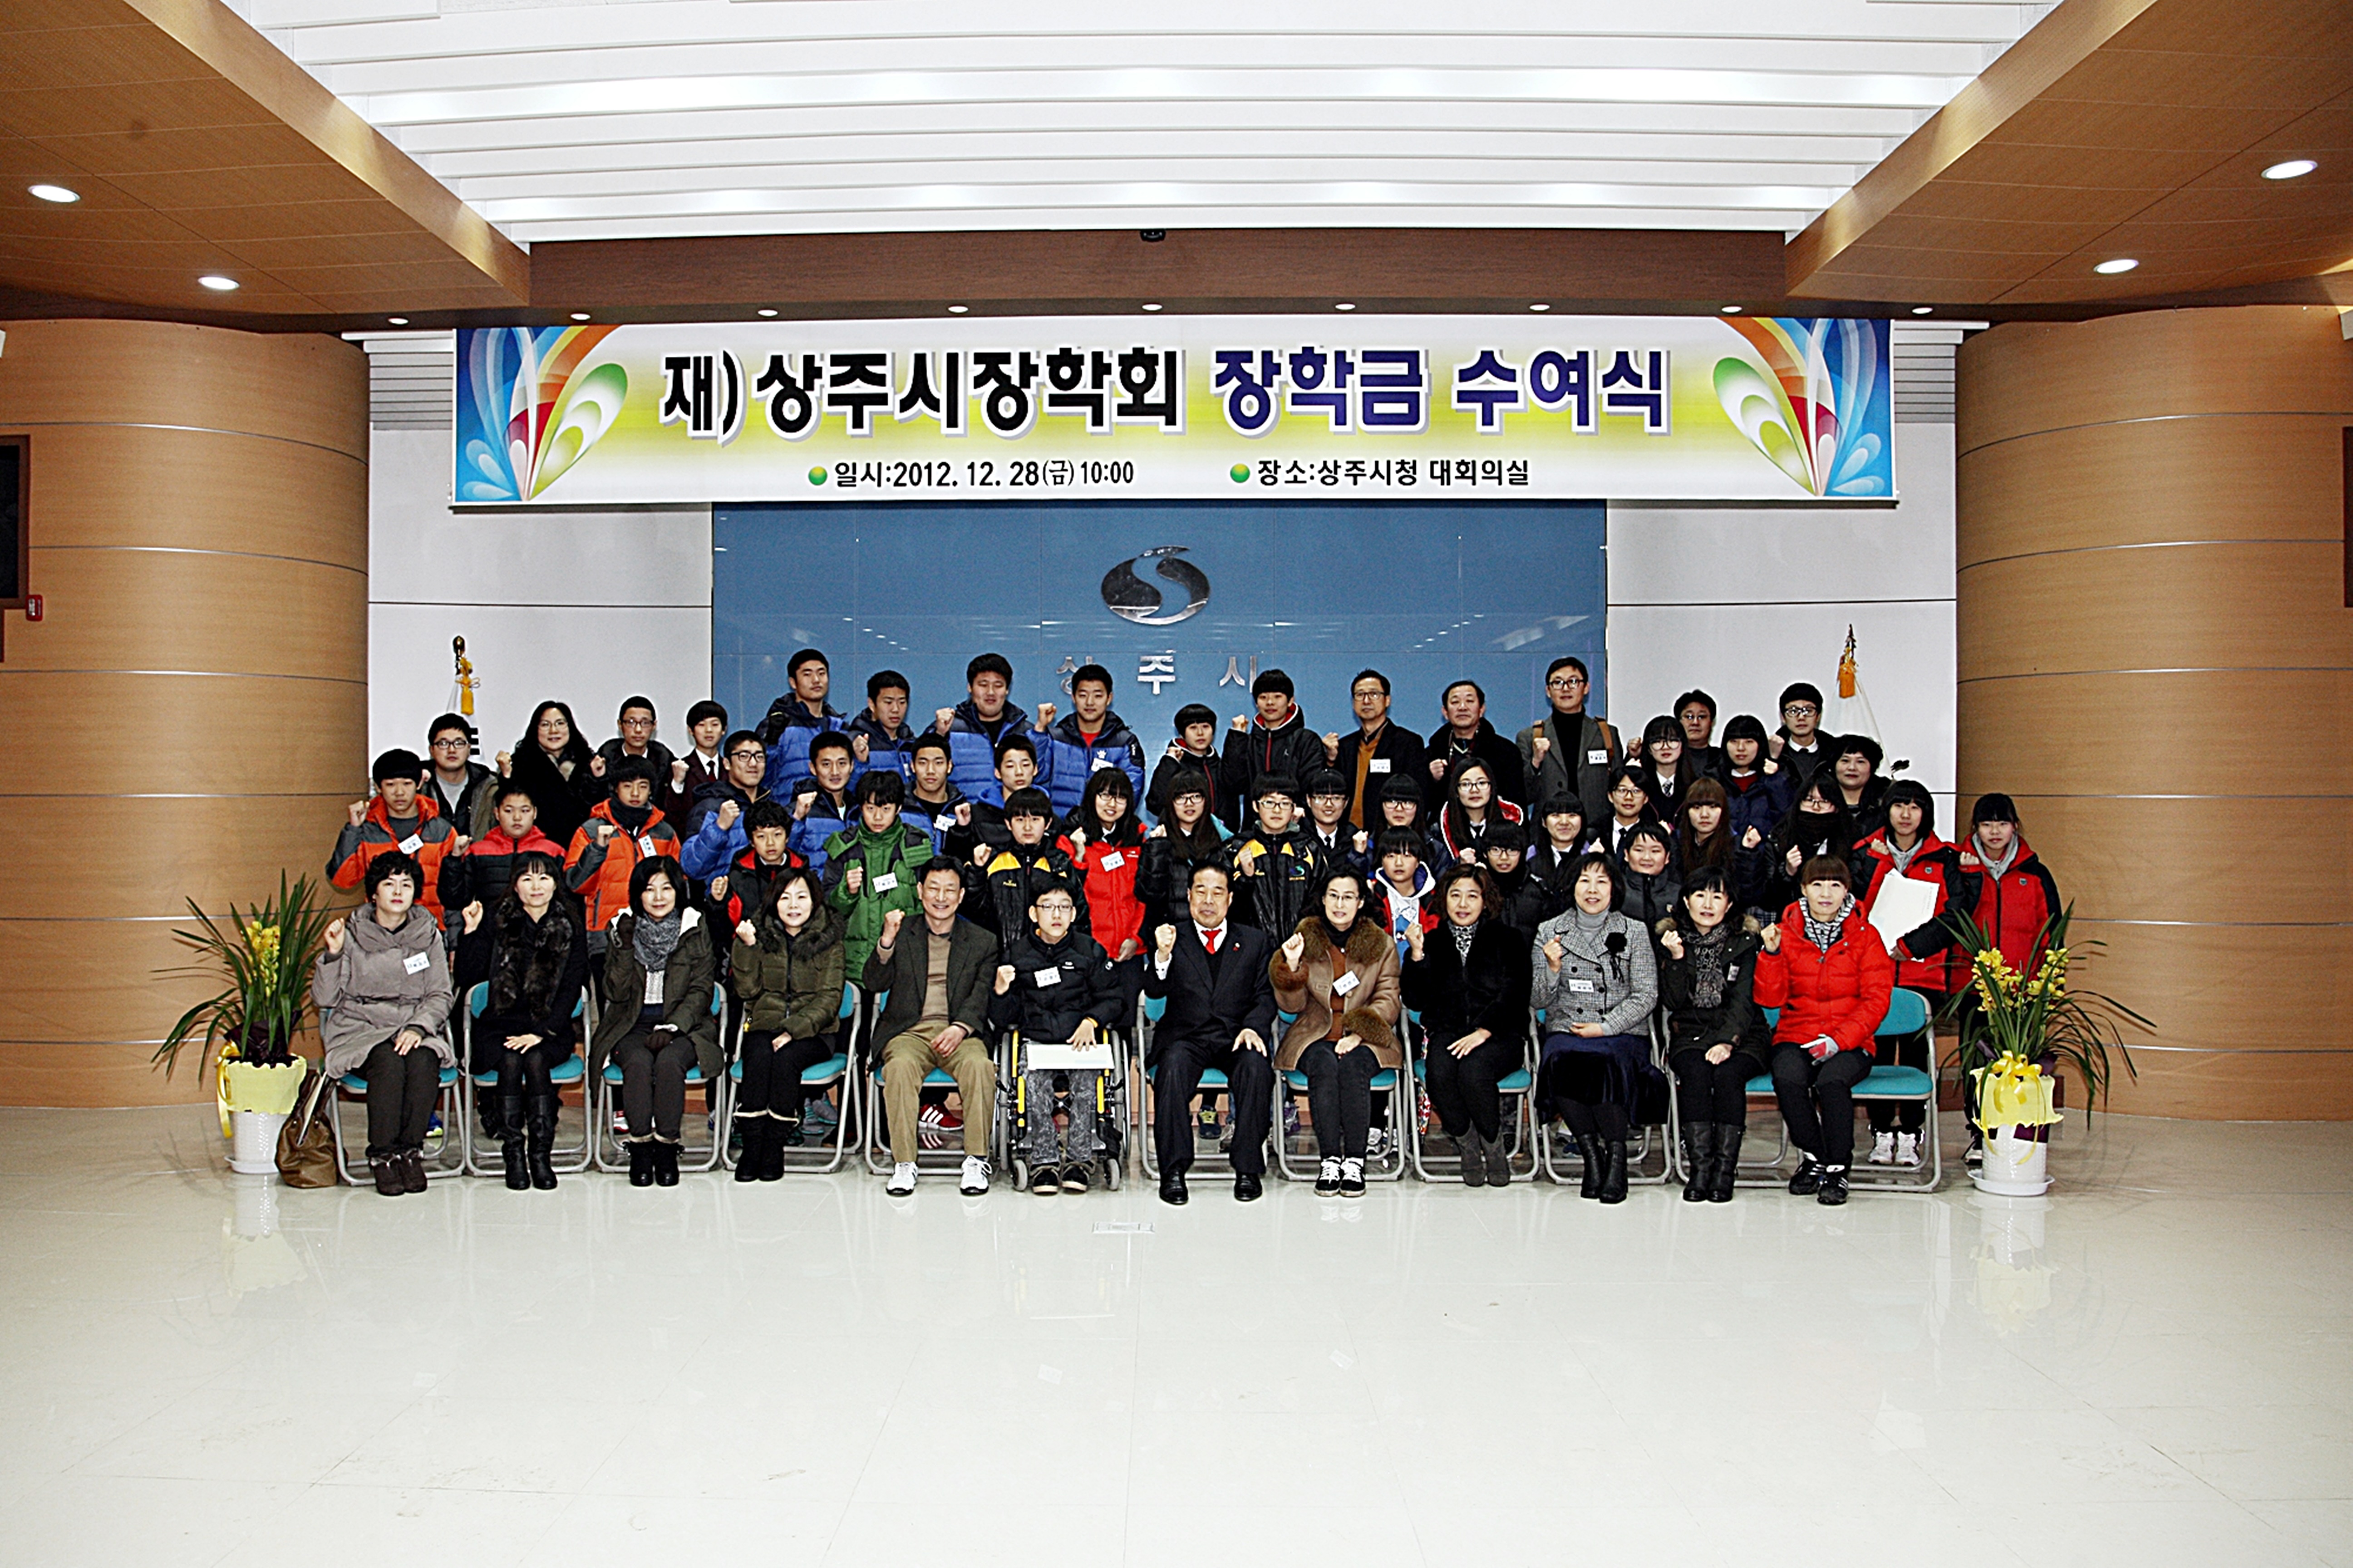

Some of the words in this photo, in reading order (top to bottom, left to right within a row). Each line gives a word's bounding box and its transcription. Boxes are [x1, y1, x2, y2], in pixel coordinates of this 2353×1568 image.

[1214, 347, 1424, 430] 장학금
[1455, 350, 1663, 428] 수여식
[1080, 460, 1134, 485] 10:00
[1257, 459, 1417, 487] 장소:상주시청
[1429, 459, 1529, 487] 대회의실
